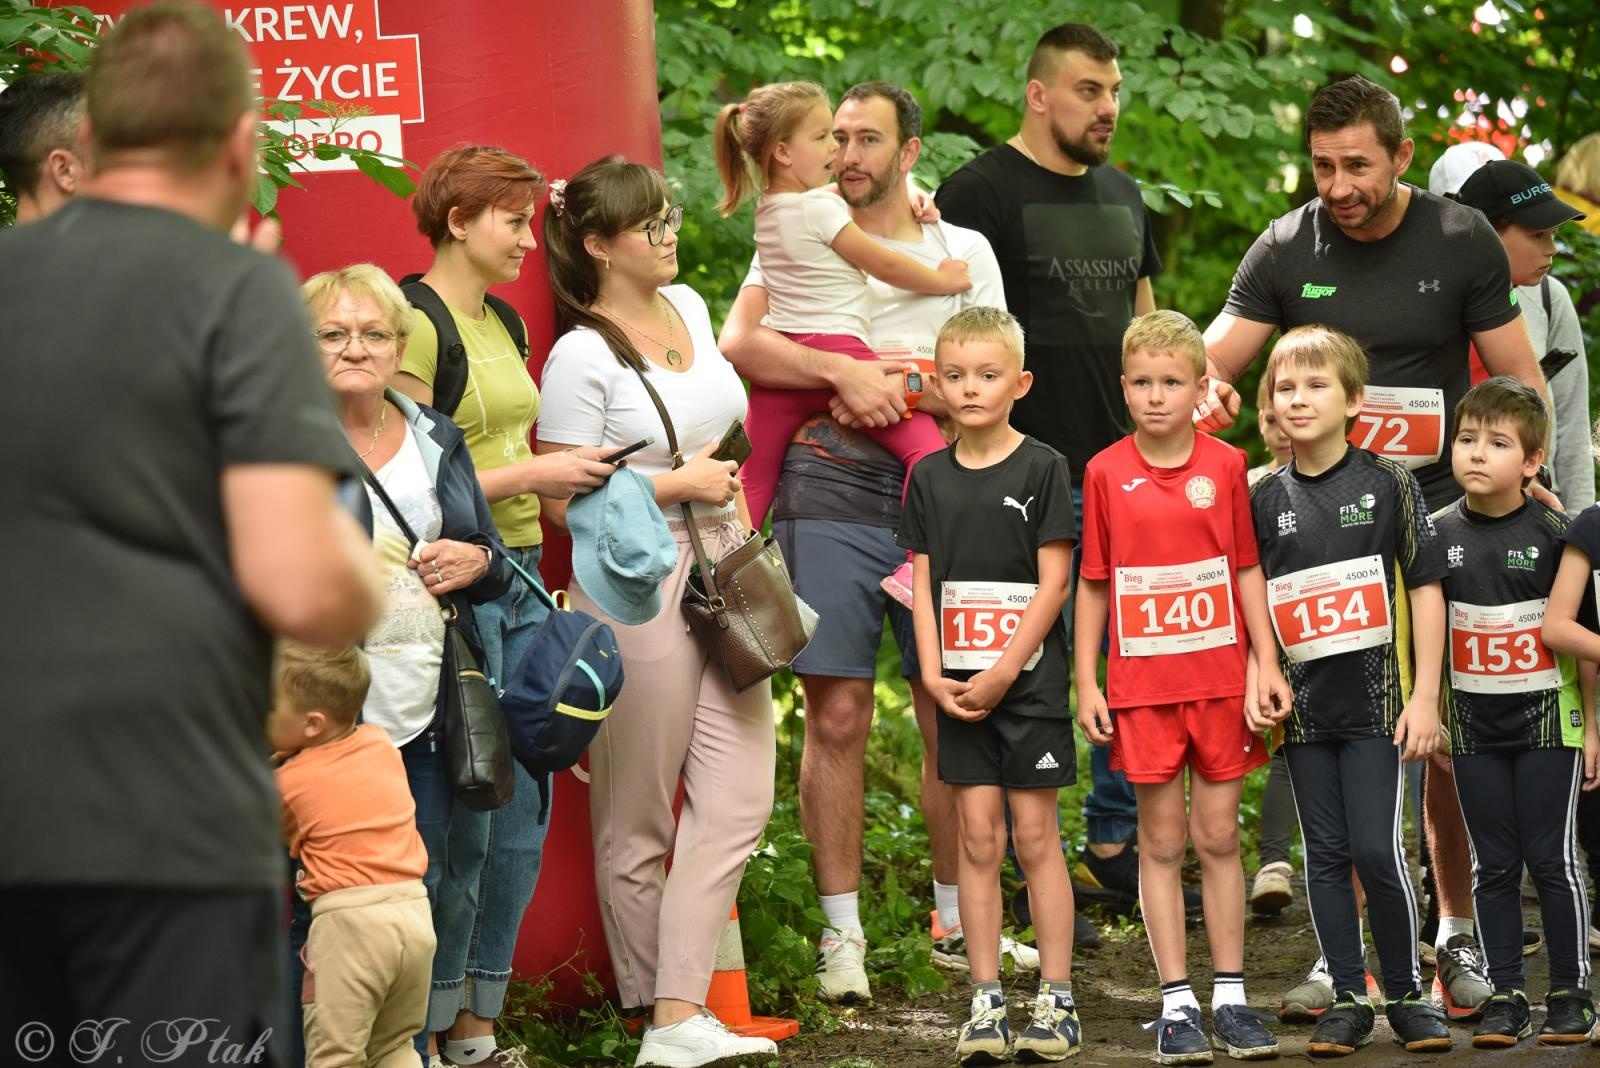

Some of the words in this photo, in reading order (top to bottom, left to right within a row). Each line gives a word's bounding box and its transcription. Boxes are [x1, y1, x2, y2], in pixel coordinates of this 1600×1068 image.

[224, 3, 363, 44] KREW,
[275, 58, 399, 101] ŻYCIE
[1070, 279, 1126, 291] CREED
[1408, 399, 1430, 408] 4500
[1431, 400, 1439, 408] M
[1359, 414, 1409, 452] 72
[1340, 511, 1373, 524] MORE
[1508, 558, 1536, 568] MORE
[1124, 573, 1143, 584] Bieg
[1196, 571, 1216, 582] 4500
[1216, 569, 1225, 578] M
[1345, 570, 1369, 581] 4500
[1369, 568, 1379, 577] M
[1275, 581, 1293, 592] Bieg
[1007, 594, 1028, 603] 4500
[1138, 591, 1215, 634] 140
[1292, 589, 1370, 639] 154
[1518, 613, 1537, 623] 4500
[952, 611, 1022, 648] 159
[1464, 633, 1539, 672] 153
